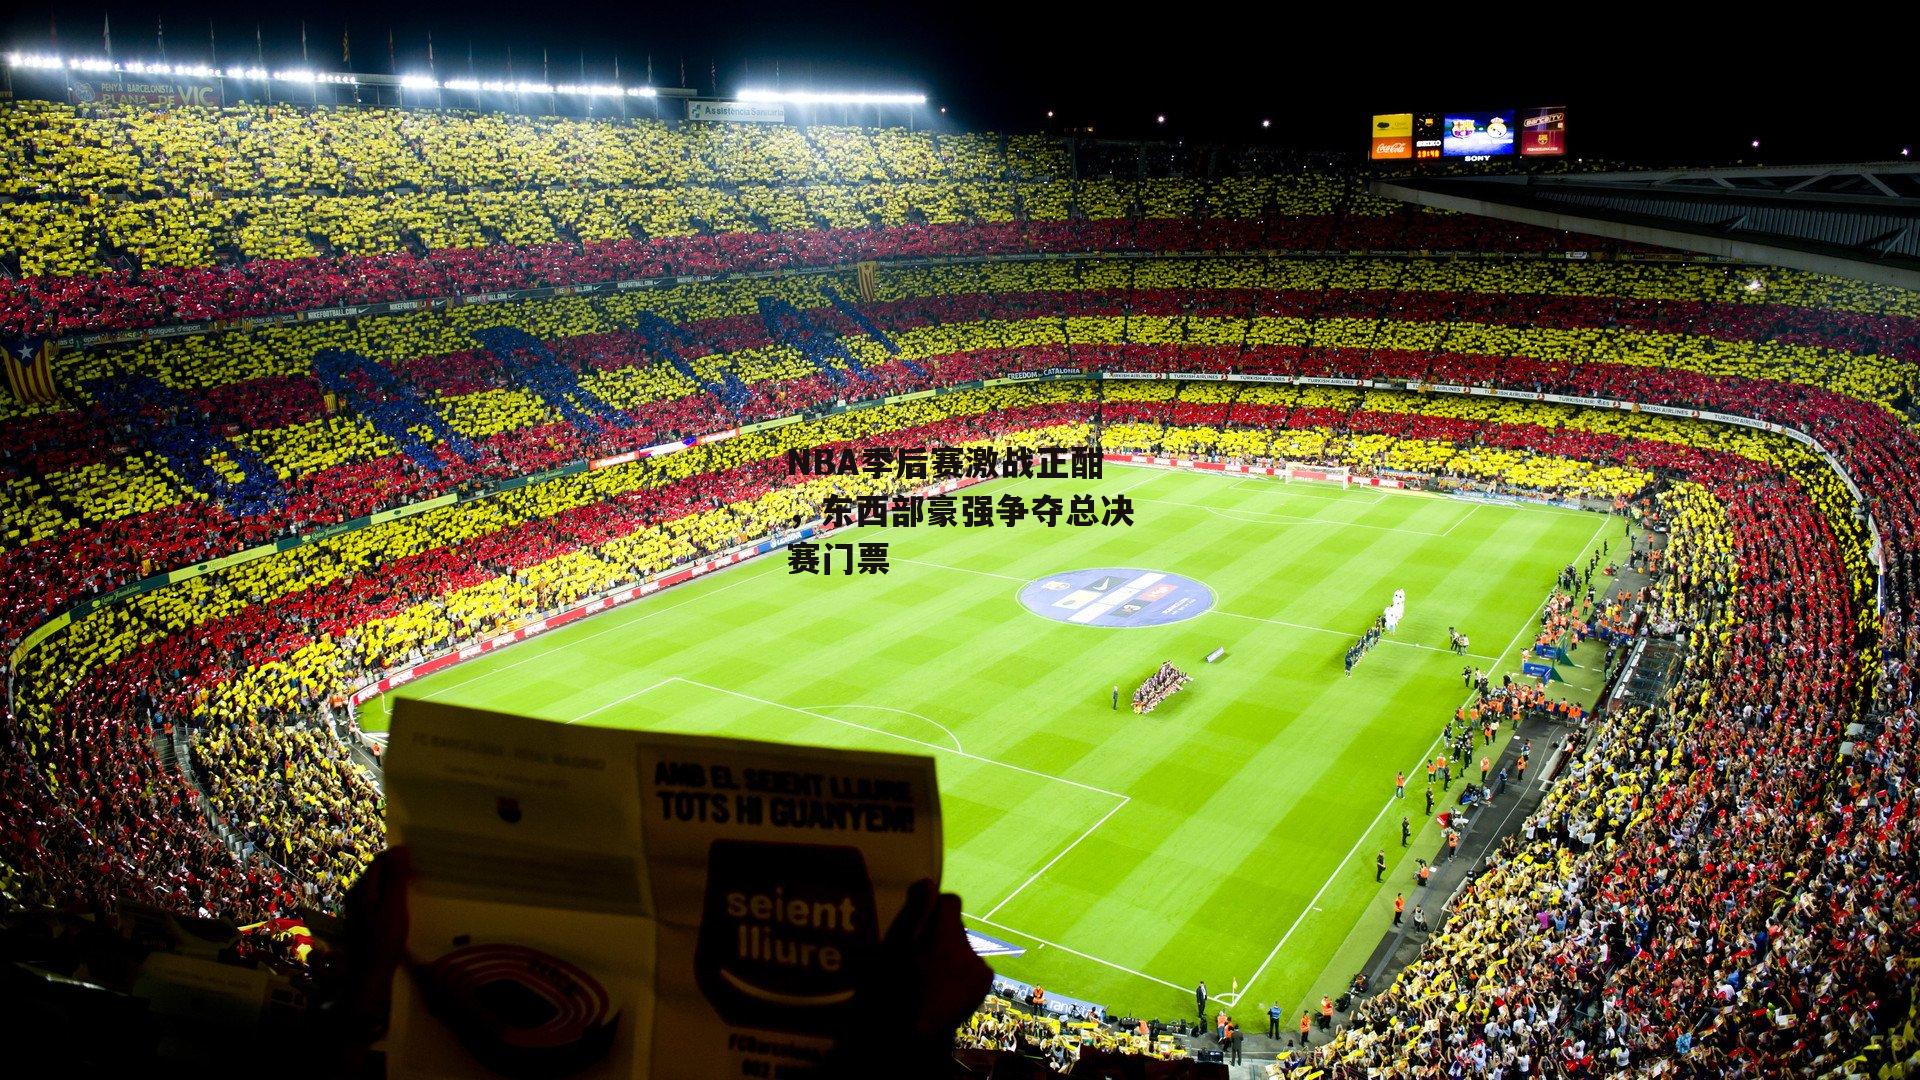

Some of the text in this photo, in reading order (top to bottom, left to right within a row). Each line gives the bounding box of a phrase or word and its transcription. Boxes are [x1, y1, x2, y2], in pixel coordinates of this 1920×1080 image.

[101, 83, 123, 92] PENYA
[177, 86, 213, 105] VIC
[307, 308, 358, 318] NIKEFOOTBALL.COM
[1007, 371, 1039, 380] FREEDOM
[1043, 367, 1081, 376] CATALONIA
[1713, 413, 1740, 422] TURKISH
[655, 761, 706, 787] AMB
[710, 765, 740, 790] EL
[742, 768, 823, 797] SEIENT
[656, 790, 730, 824] TOTS
[735, 795, 763, 826] HI
[724, 884, 857, 933] seient
[737, 923, 845, 973] lliure
